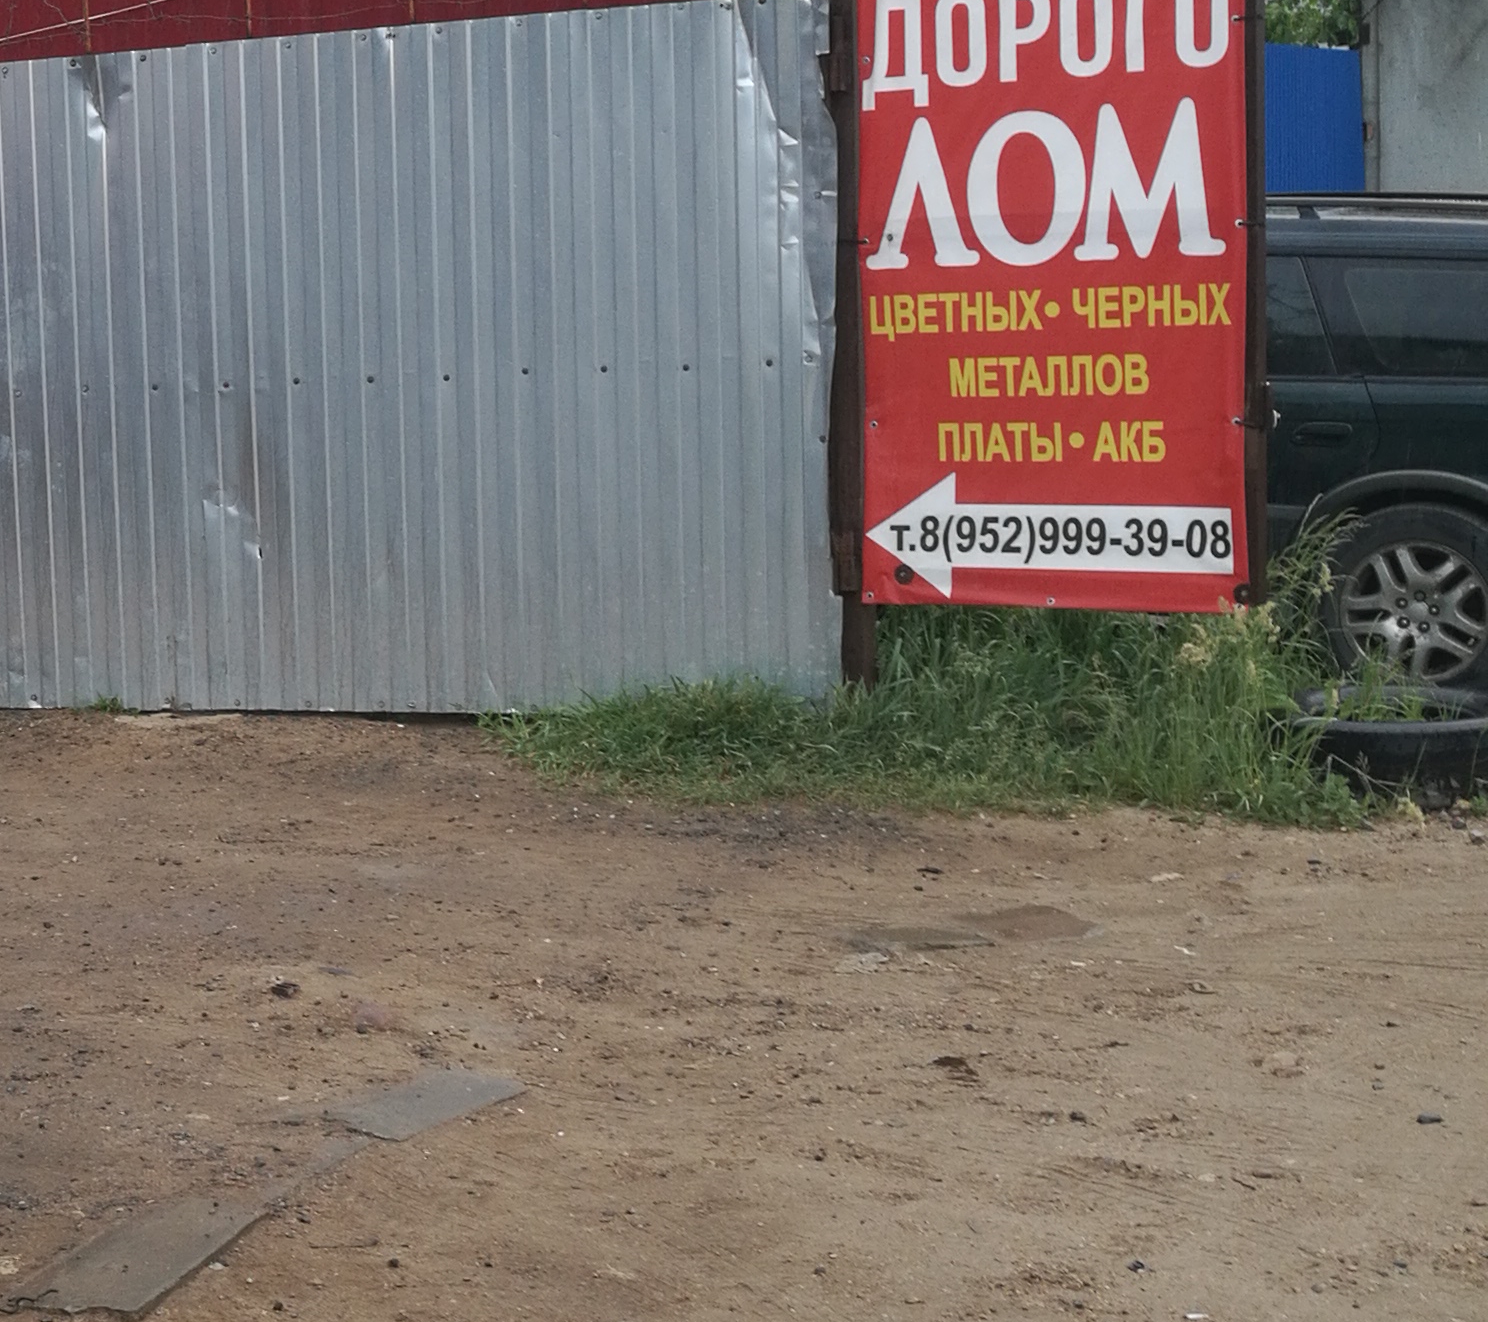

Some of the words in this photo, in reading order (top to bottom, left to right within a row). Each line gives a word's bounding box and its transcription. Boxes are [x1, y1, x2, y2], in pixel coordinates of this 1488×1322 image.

[865, 96, 1227, 270] ЛОМ
[869, 289, 1043, 342] ЦВЕТНЫХ
[1072, 283, 1231, 328] ЧЕРНЫХ
[949, 353, 1149, 397] МЕТАЛЛОВ
[938, 422, 1062, 462] ПЛАТЫ
[1092, 420, 1166, 462] АКБ
[889, 514, 1231, 564] т.8(952)999-39-08
